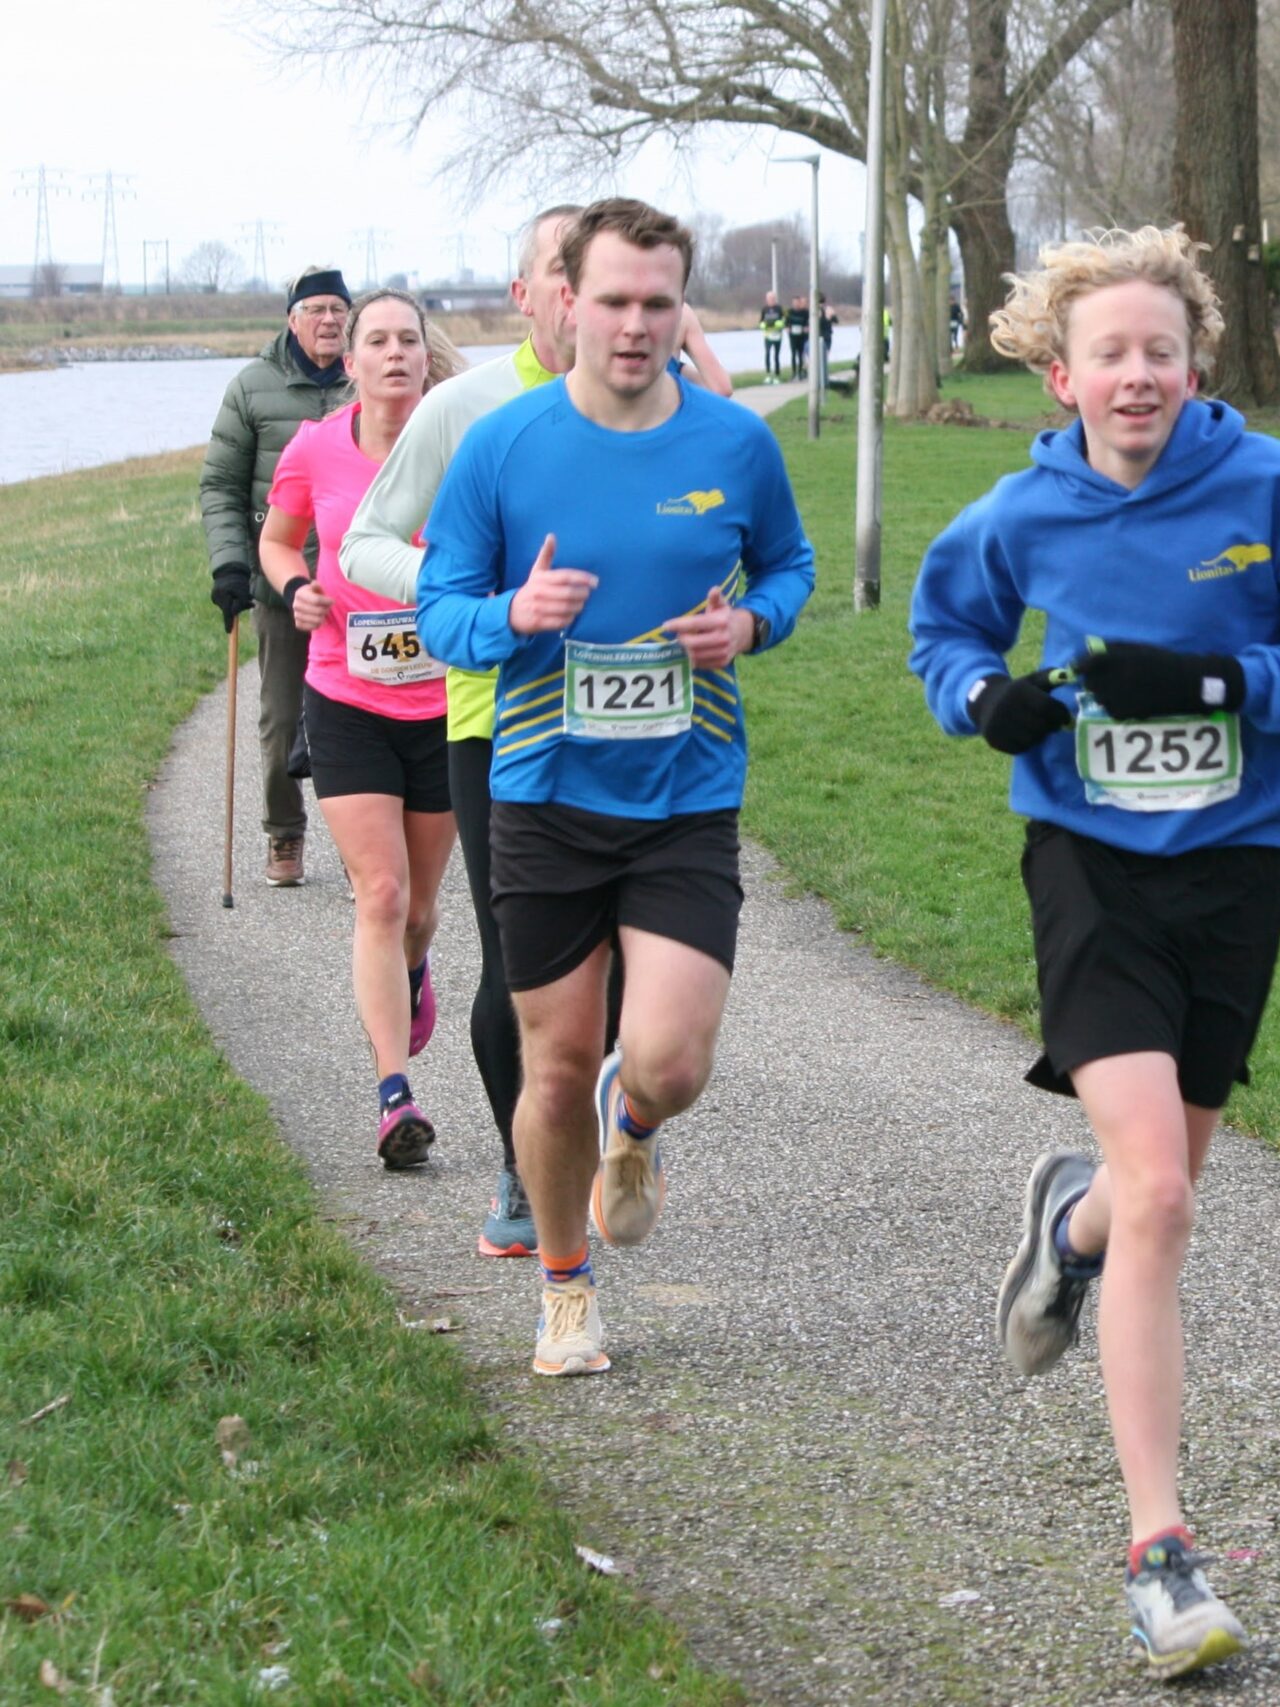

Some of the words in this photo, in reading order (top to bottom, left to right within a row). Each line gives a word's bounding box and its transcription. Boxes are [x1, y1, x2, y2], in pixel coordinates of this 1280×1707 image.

[1188, 567, 1234, 582] Lionitas
[361, 631, 420, 661] 645
[579, 670, 676, 710] 1221
[1094, 726, 1224, 774] 1252
